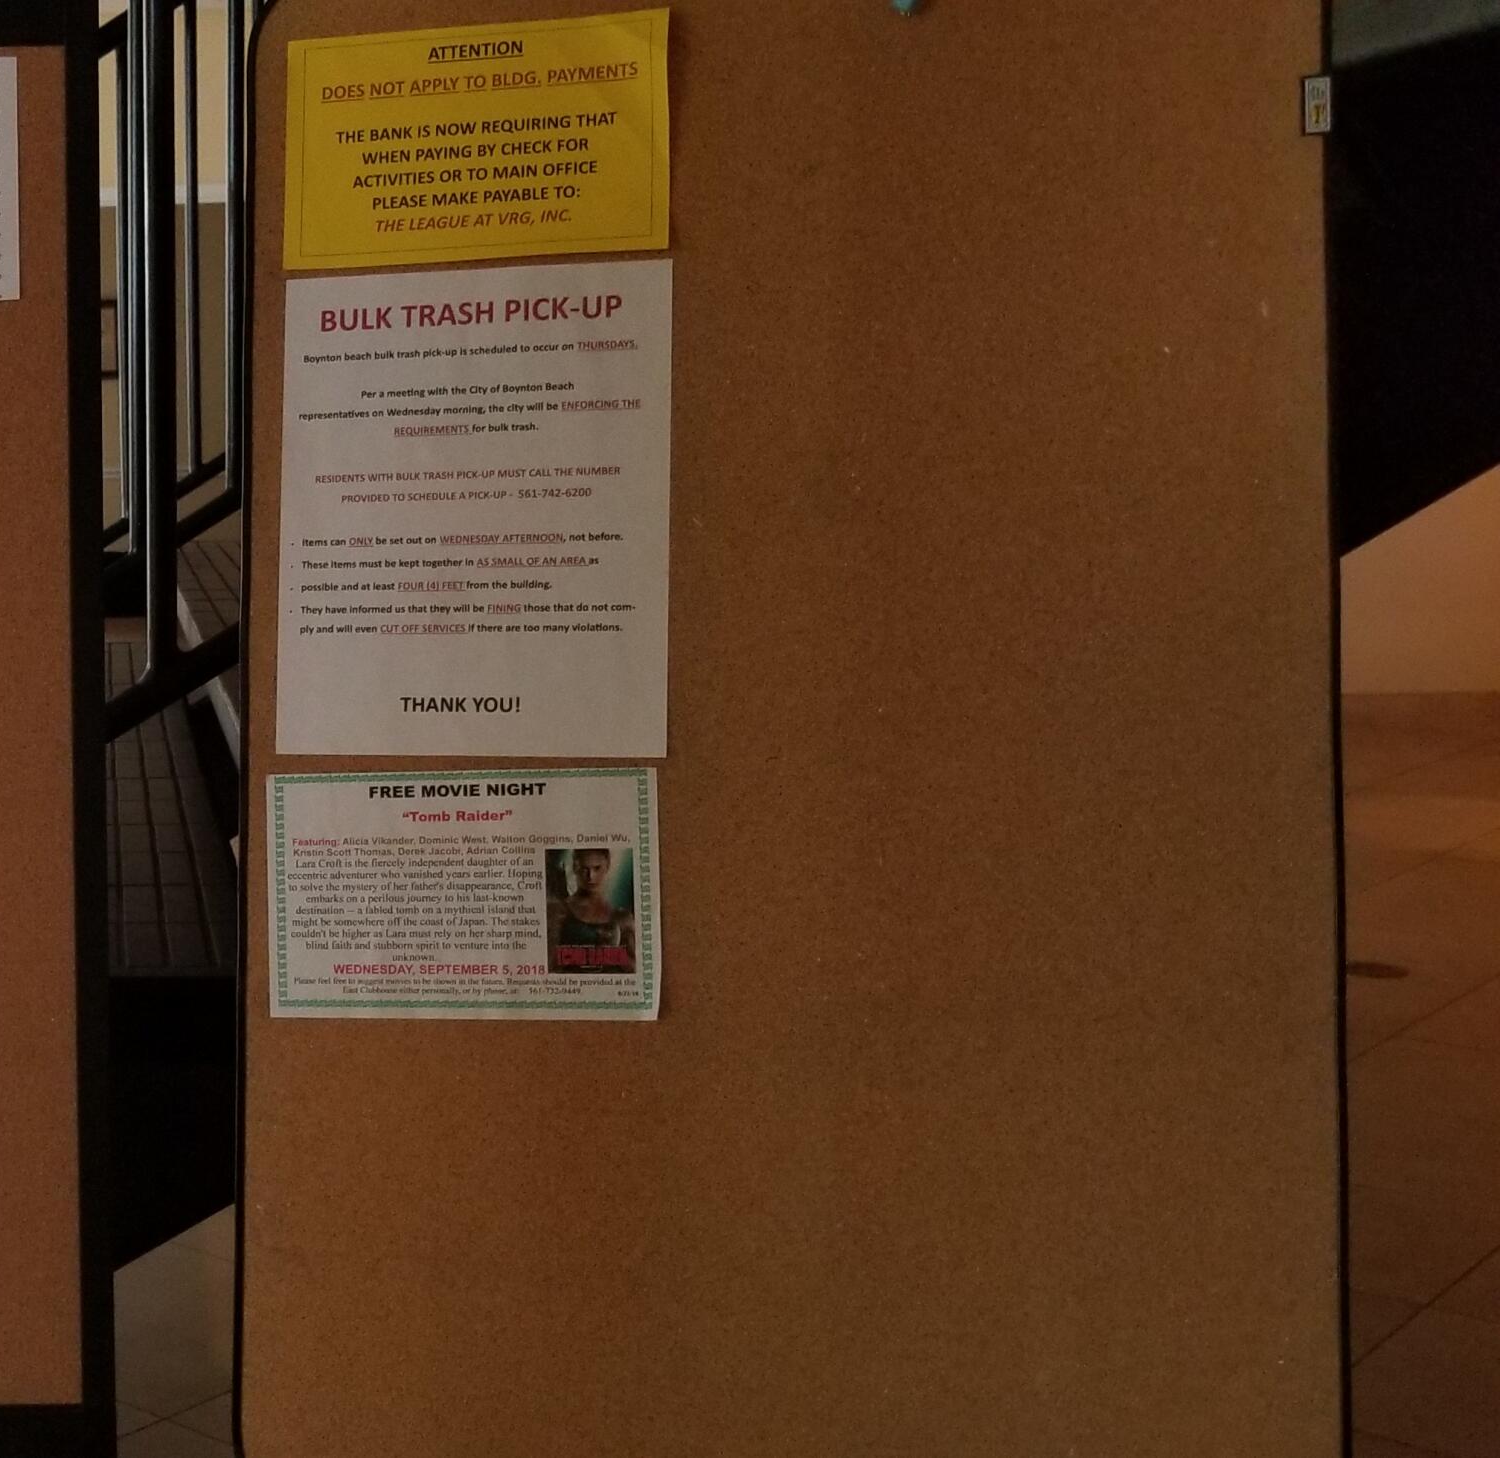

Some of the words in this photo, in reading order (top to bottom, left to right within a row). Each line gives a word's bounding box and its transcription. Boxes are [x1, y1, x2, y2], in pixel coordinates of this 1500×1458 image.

[428, 39, 523, 63] ATTENTION
[322, 83, 365, 100] DOES
[369, 80, 405, 96] NOT
[409, 76, 460, 97] APPLY
[462, 73, 487, 92] TO
[546, 61, 638, 86] PAYMENTS
[361, 149, 410, 165] WHEN
[415, 144, 471, 162] PAYING
[477, 143, 496, 157] BY
[500, 139, 552, 155] CHECK
[557, 137, 588, 152] FOR
[320, 306, 391, 332] BULK
[400, 300, 493, 328] TRASH
[504, 294, 622, 322] PICK-UP
[361, 390, 376, 398] Per
[386, 387, 425, 398] meeting
[426, 386, 448, 396] with
[450, 385, 467, 395] the
[469, 385, 488, 395] City
[489, 383, 500, 393] of
[502, 383, 542, 394] Boynton
[544, 380, 574, 391] Beach
[315, 473, 365, 483] RESIDENTS
[367, 472, 393, 482] WITH
[395, 471, 420, 480] BULK
[422, 470, 453, 480] TRASH
[456, 469, 495, 480] PICK-UP
[497, 467, 526, 478] MUST
[528, 467, 552, 477] CALL
[553, 466, 573, 477] THE
[575, 464, 620, 476] NUMBER
[391, 493, 405, 501] TO
[407, 491, 456, 501] SCHEDULE
[458, 491, 466, 500] A
[467, 489, 506, 499] PICK-UP
[517, 487, 592, 499] 561-742-6200
[399, 696, 466, 712] THANK
[472, 696, 520, 712] YOU!
[368, 785, 415, 798] FREE
[421, 783, 480, 797] MOVIE
[486, 782, 546, 796] NIGHT
[295, 859, 315, 868] Lara
[317, 858, 342, 868] Croft
[344, 858, 352, 868] is
[354, 858, 368, 867] the
[371, 857, 405, 869] fiercely
[408, 856, 463, 868] independent
[466, 856, 507, 868] daughter
[509, 856, 521, 866] of
[523, 859, 534, 867] an
[333, 963, 415, 976] WEDNESDAY,
[419, 963, 498, 975] SEPTEMBER
[502, 964, 512, 977] 5,
[517, 963, 545, 975] 2018
